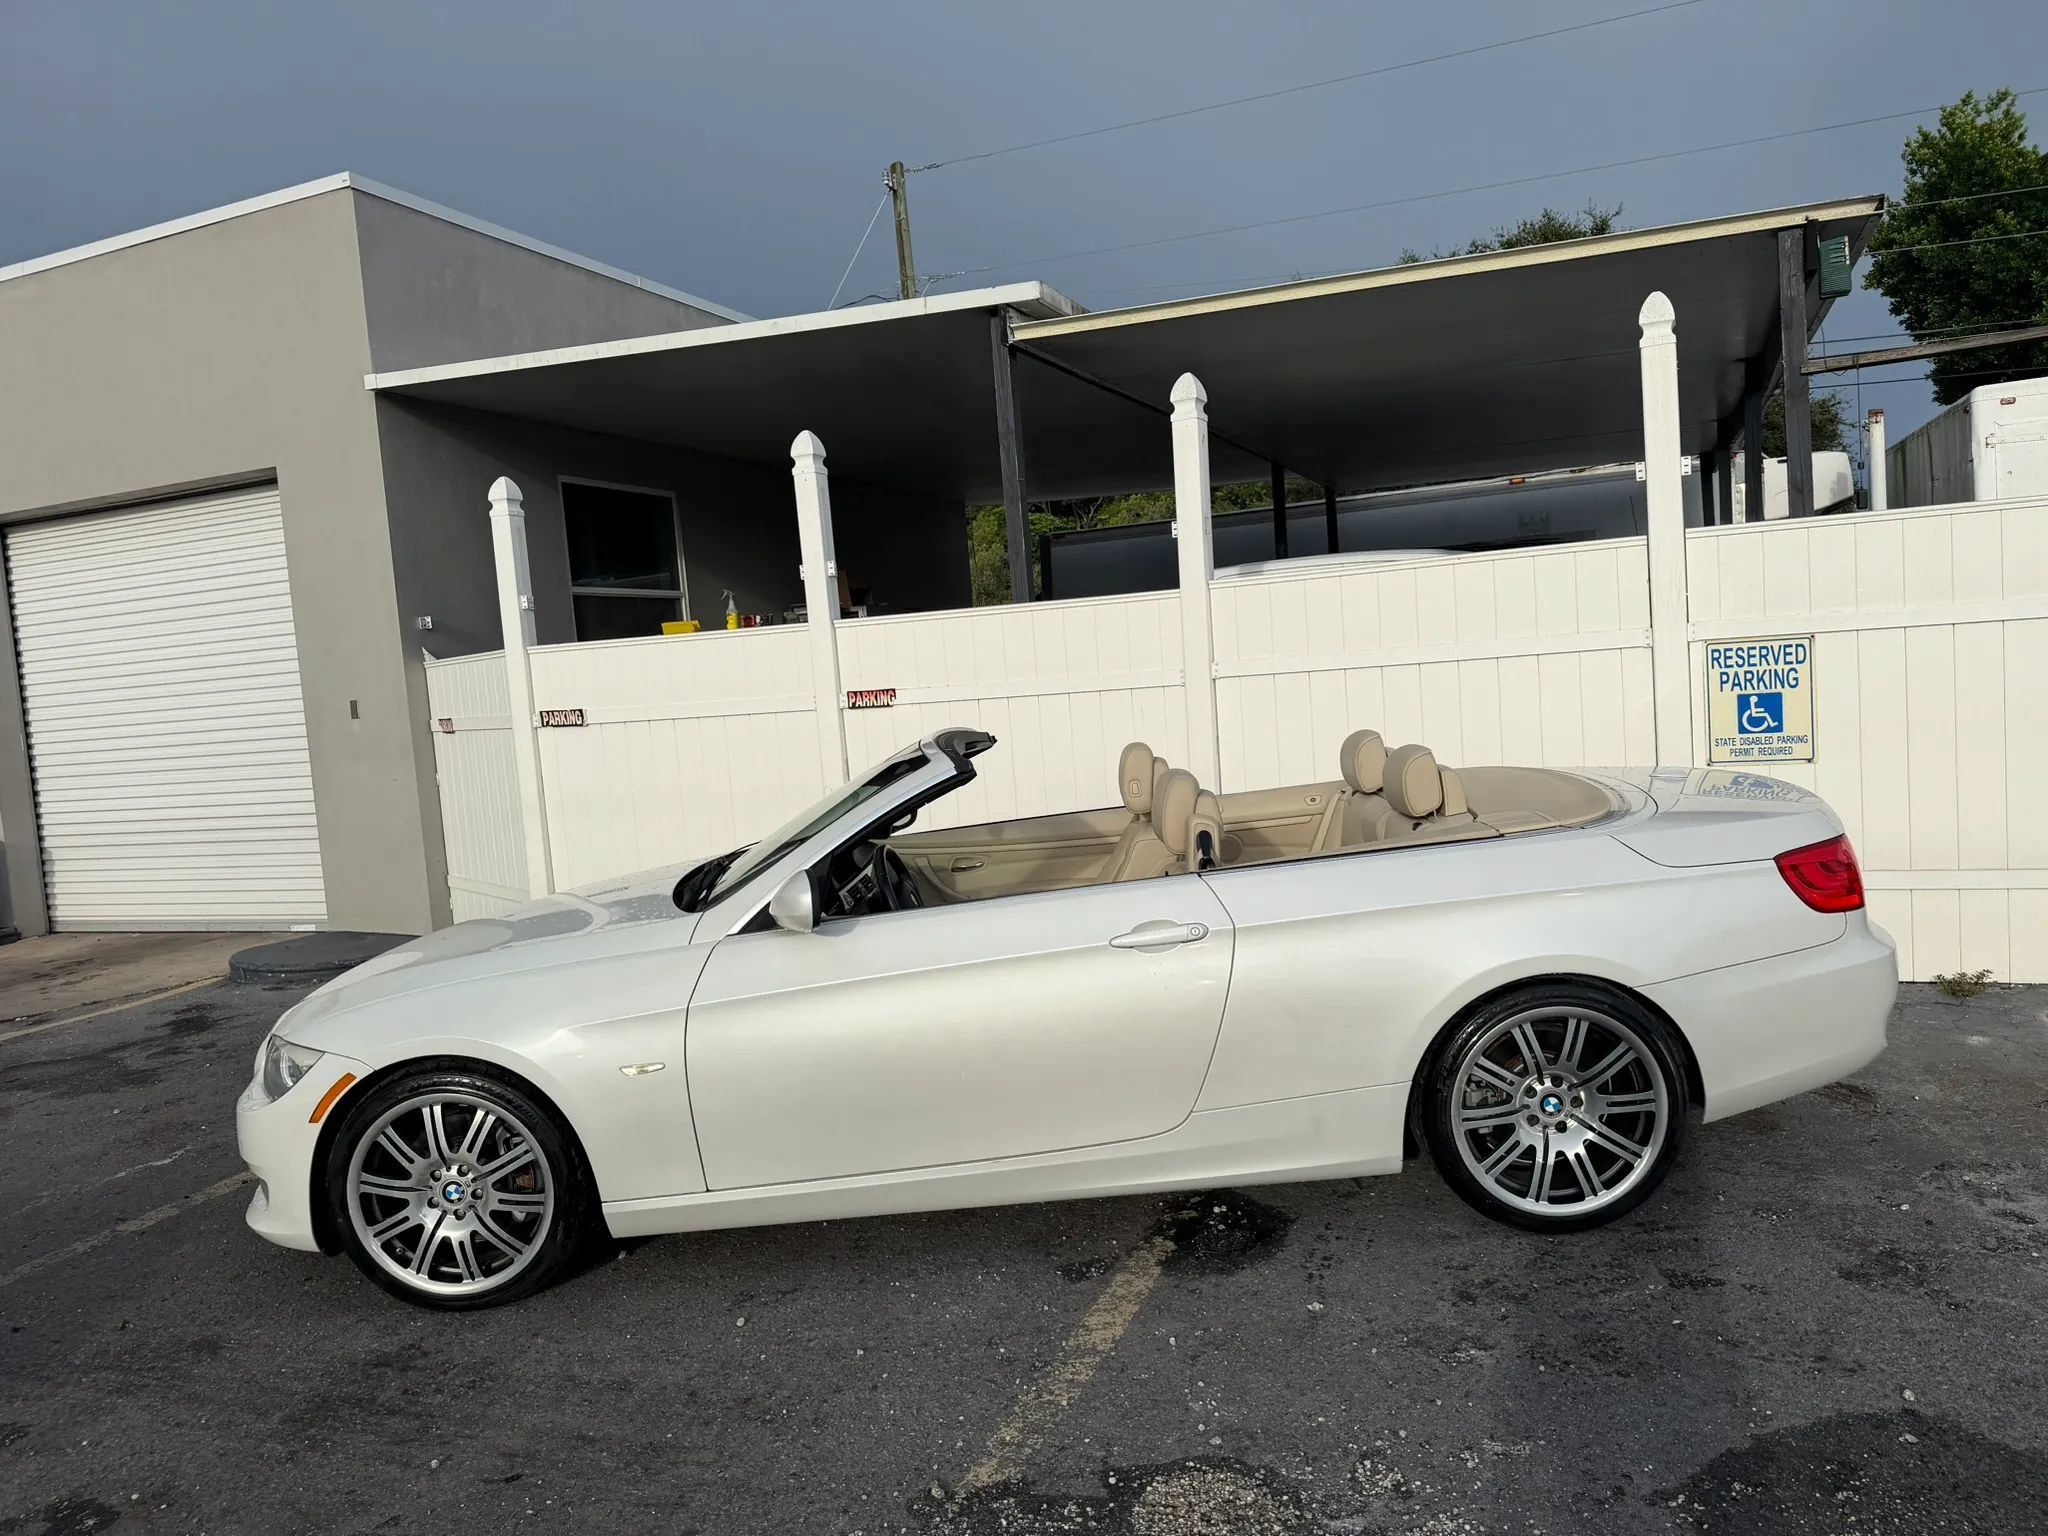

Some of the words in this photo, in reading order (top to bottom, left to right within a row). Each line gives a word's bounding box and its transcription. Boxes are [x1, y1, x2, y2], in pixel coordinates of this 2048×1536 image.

[1711, 643, 1807, 669] RESERVED
[1719, 667, 1799, 692] PARKING
[848, 690, 895, 707] PARKING
[542, 710, 583, 726] PARKING
[1715, 738, 1737, 747] STATE
[1740, 736, 1774, 746] DISABLED
[1777, 734, 1808, 744] PARKING
[1730, 747, 1755, 757] PERMIT
[1758, 746, 1793, 756] REQUIRED
